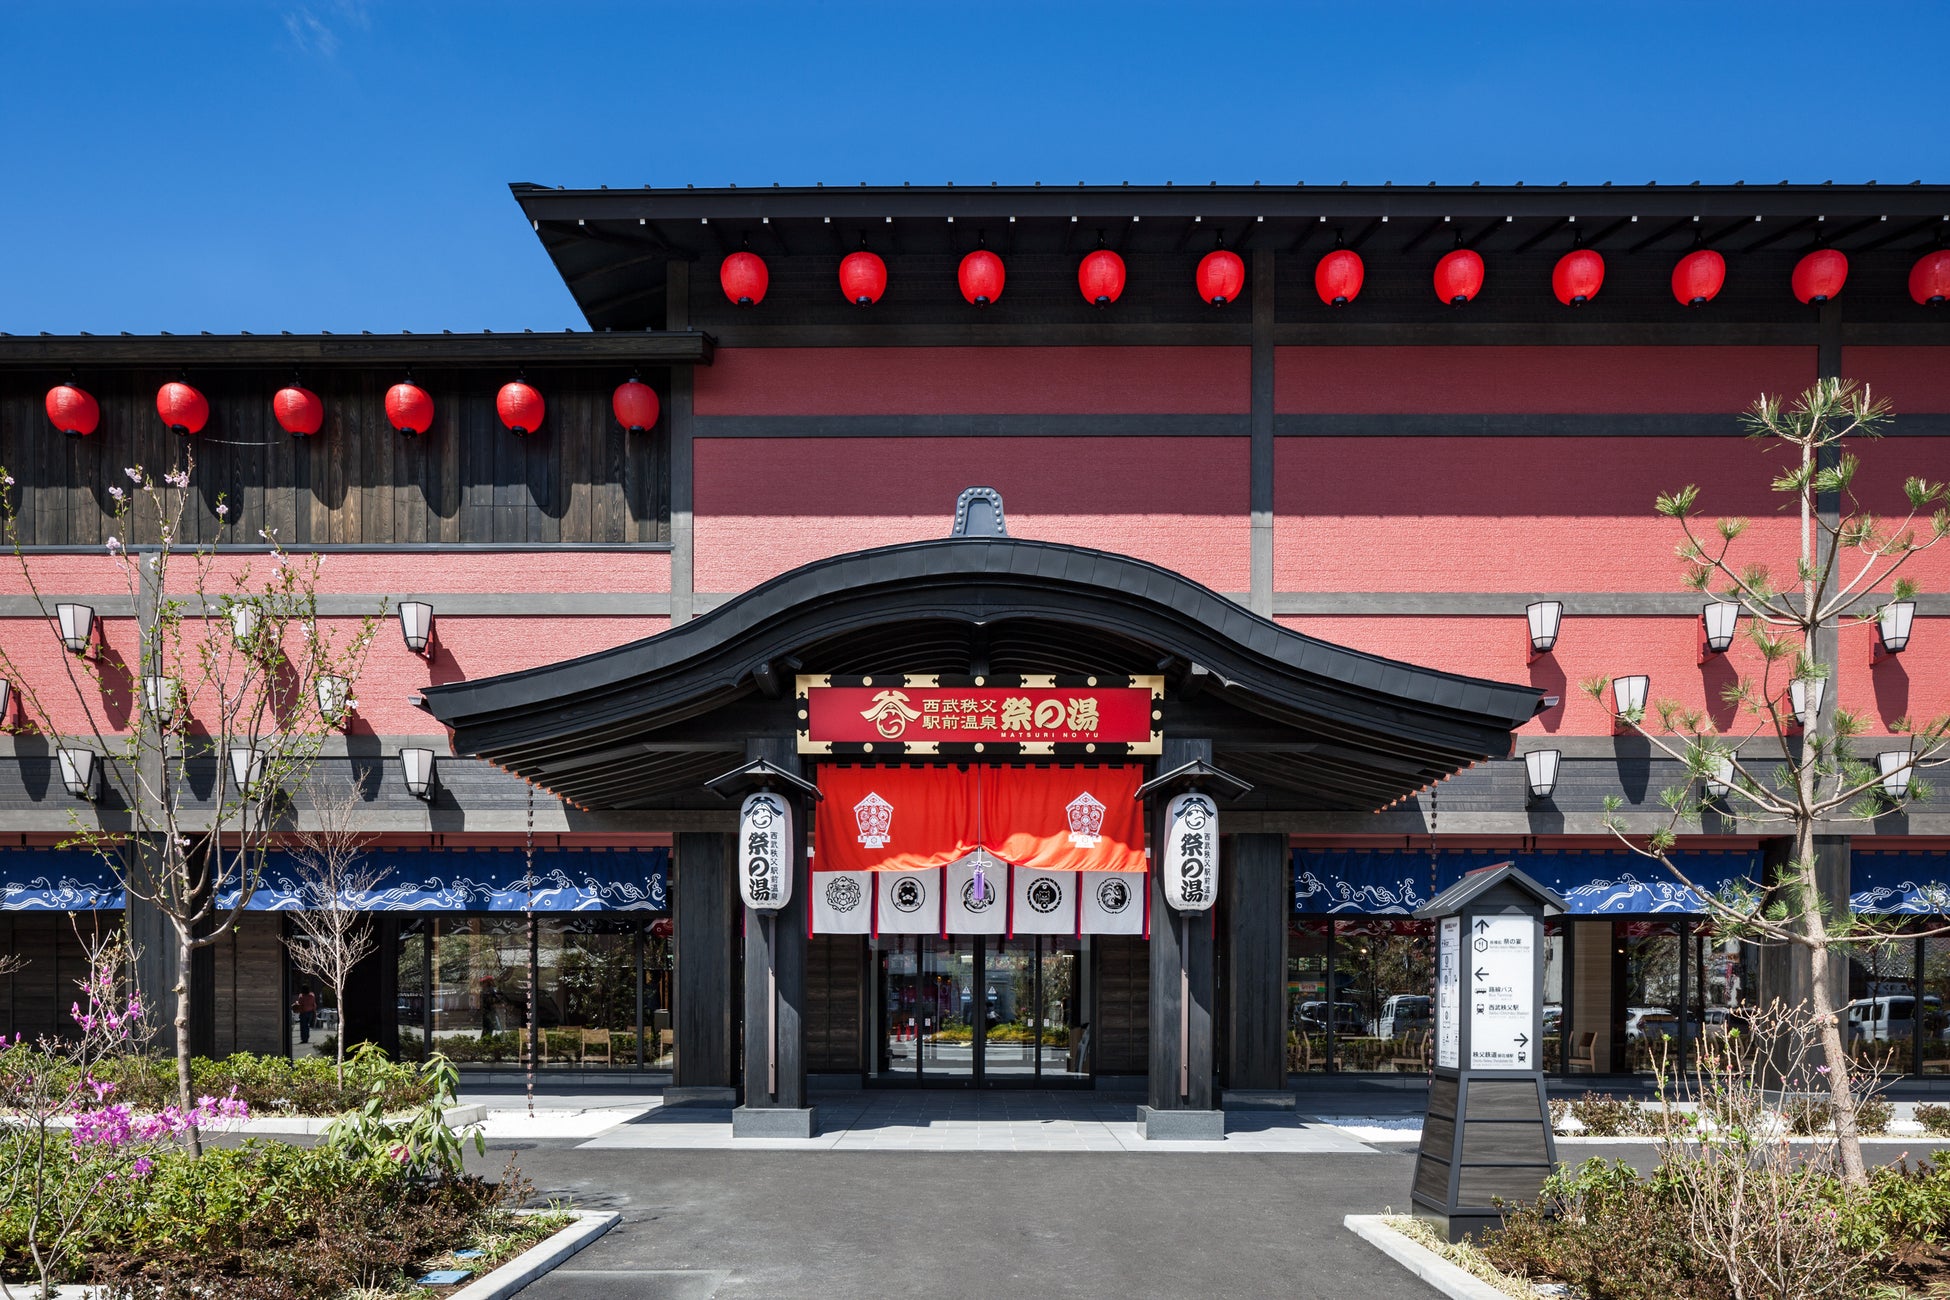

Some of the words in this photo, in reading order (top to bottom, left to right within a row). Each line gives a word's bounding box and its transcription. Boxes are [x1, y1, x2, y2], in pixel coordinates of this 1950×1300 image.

[922, 698, 998, 713] 西武秩父
[922, 714, 998, 730] 駅前温泉
[1000, 697, 1100, 732] 祭の湯
[748, 831, 770, 901] 祭の湯
[770, 831, 779, 901] 西武秩父駅前温泉
[1180, 833, 1204, 903] 祭の湯
